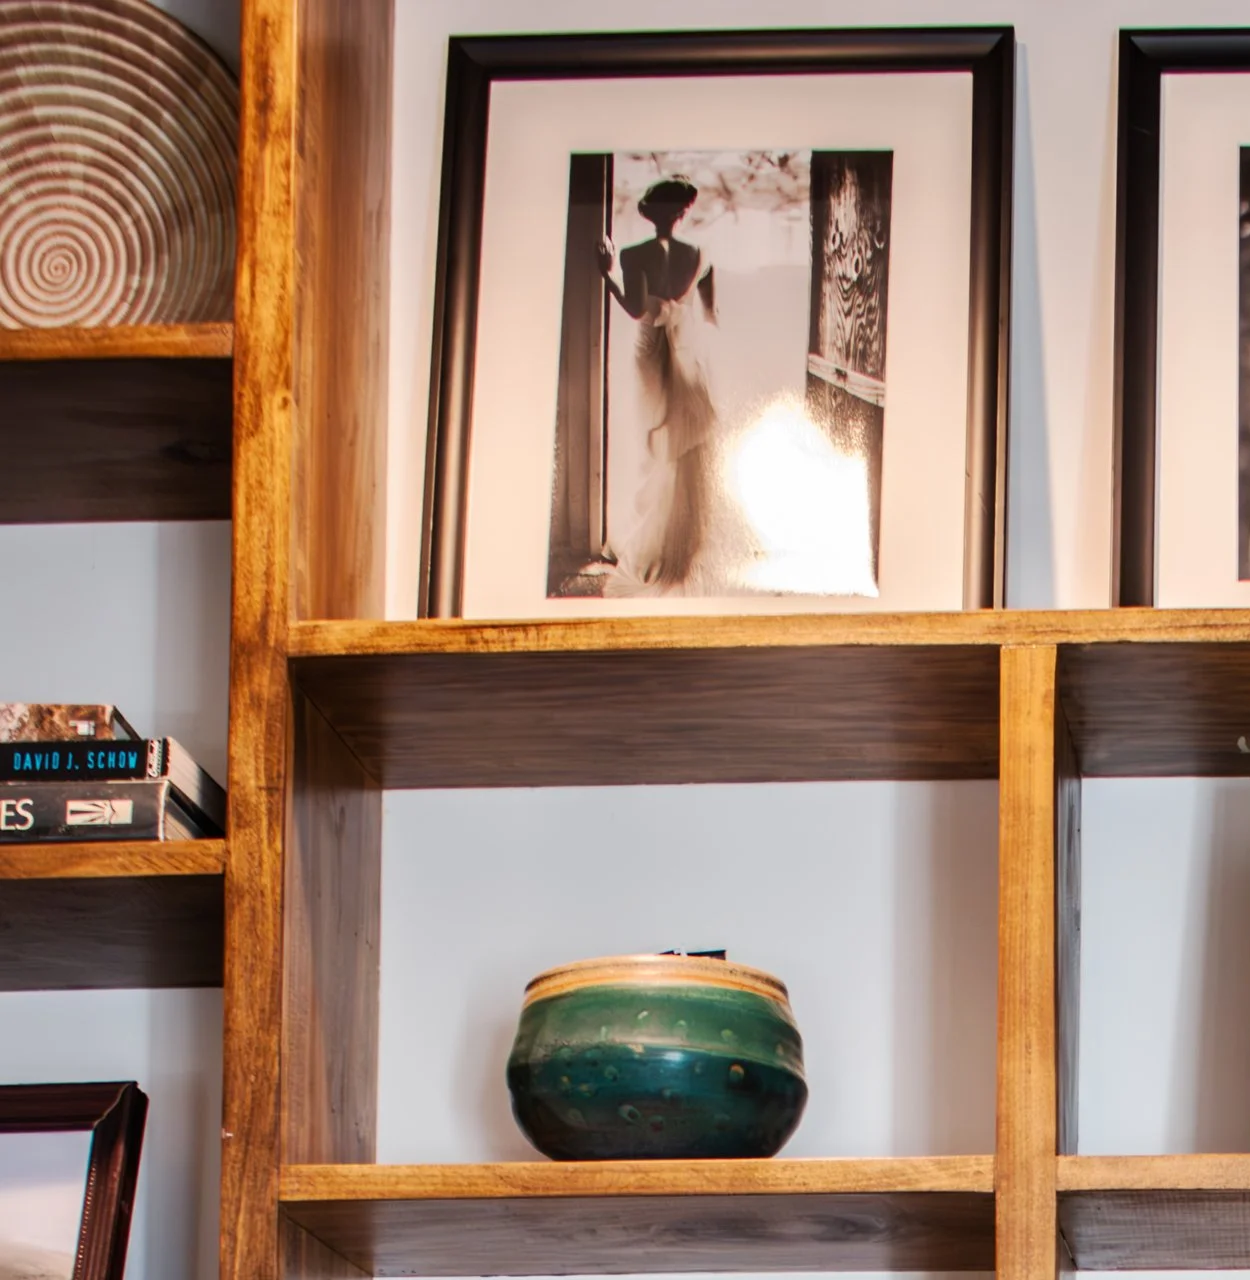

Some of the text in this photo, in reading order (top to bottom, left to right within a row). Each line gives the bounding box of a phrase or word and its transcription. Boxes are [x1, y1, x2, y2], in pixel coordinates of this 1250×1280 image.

[66, 751, 80, 770] J.
[87, 751, 138, 770] SCHOW
[0, 798, 35, 832] ES
